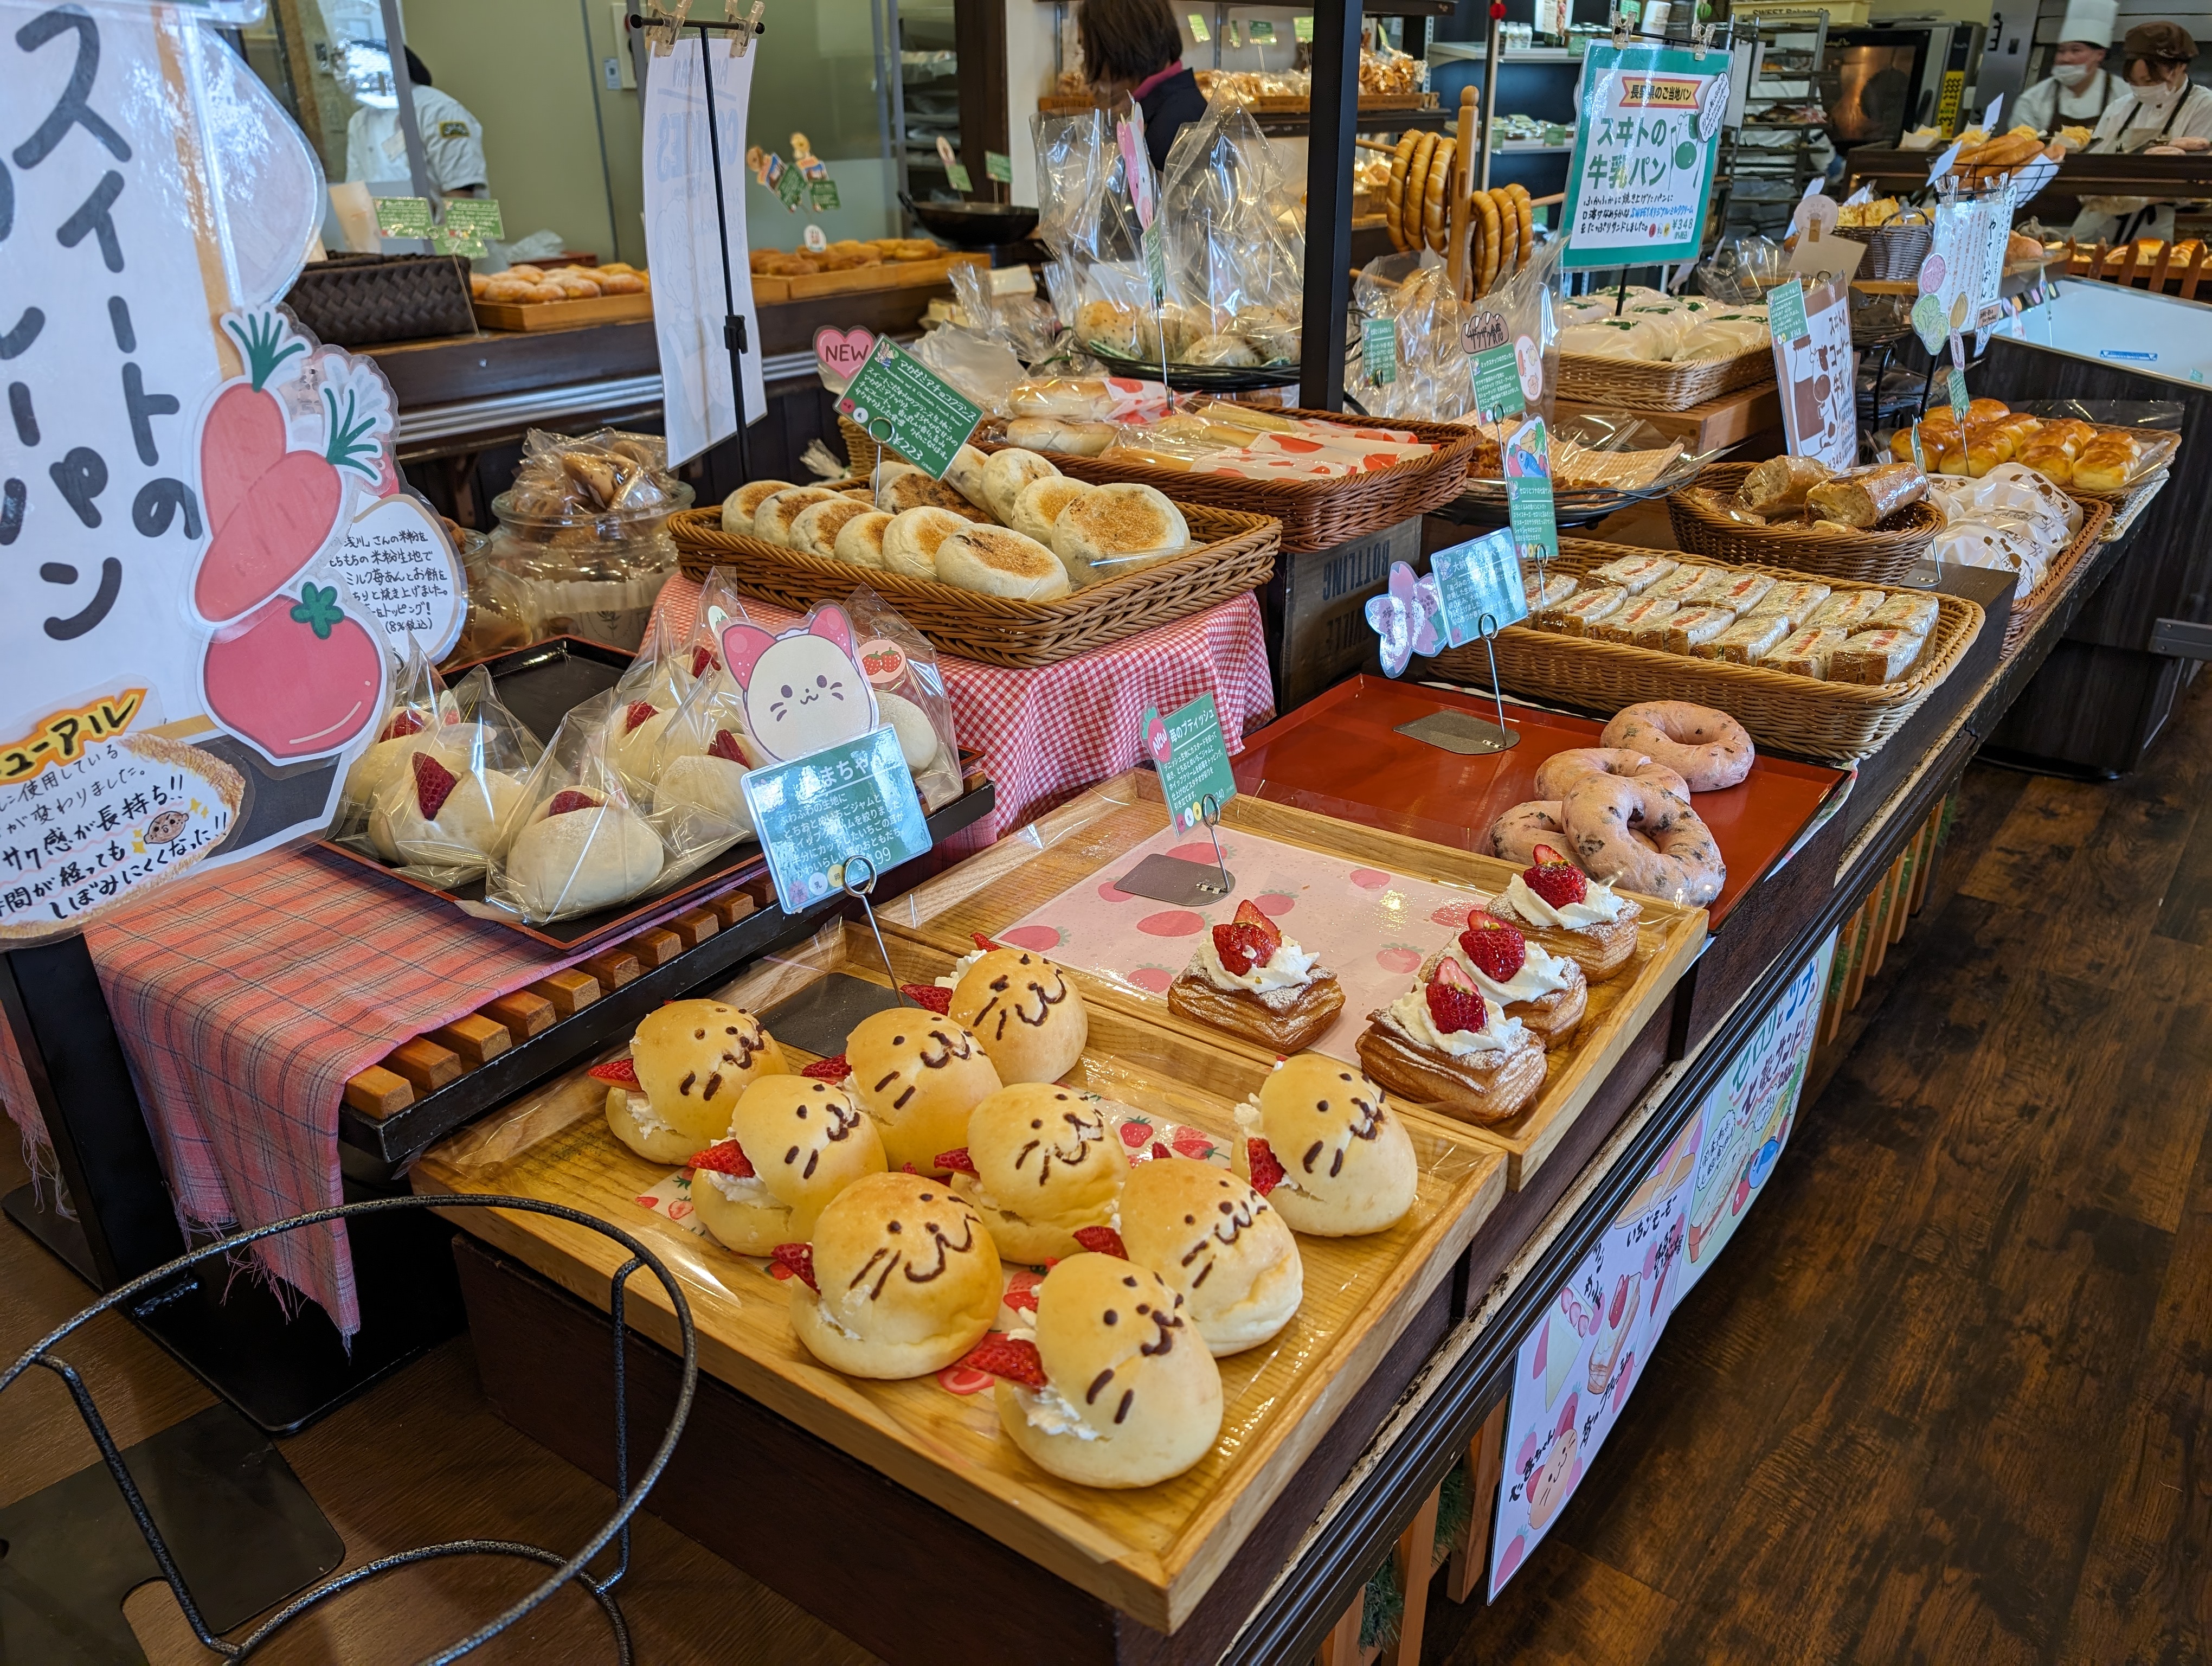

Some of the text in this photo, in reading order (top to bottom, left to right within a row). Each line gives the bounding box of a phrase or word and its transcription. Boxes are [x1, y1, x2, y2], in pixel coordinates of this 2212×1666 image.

[1630, 84, 1692, 101] 長野県のご当地パン
[1587, 154, 1666, 190] 牛乳パン
[1672, 218, 1693, 230] ¥348
[12, 4, 202, 540] スイートの
[825, 344, 869, 362] NEW
[1830, 337, 1849, 367] コーヒー
[898, 357, 978, 422] マカダミアチョコフランス
[891, 432, 924, 463] ¥223
[330, 548, 433, 567] もちもちの米粉生地で
[1322, 540, 1391, 601] BOTTLING
[1497, 612, 1511, 624] 226
[1169, 709, 1214, 743] 苺のプティッシュ
[780, 793, 848, 826] ふわふわの生地に
[1214, 789, 1225, 803] 240
[814, 881, 822, 889] 乳
[1741, 1018, 1805, 1116] 七穀サンド
